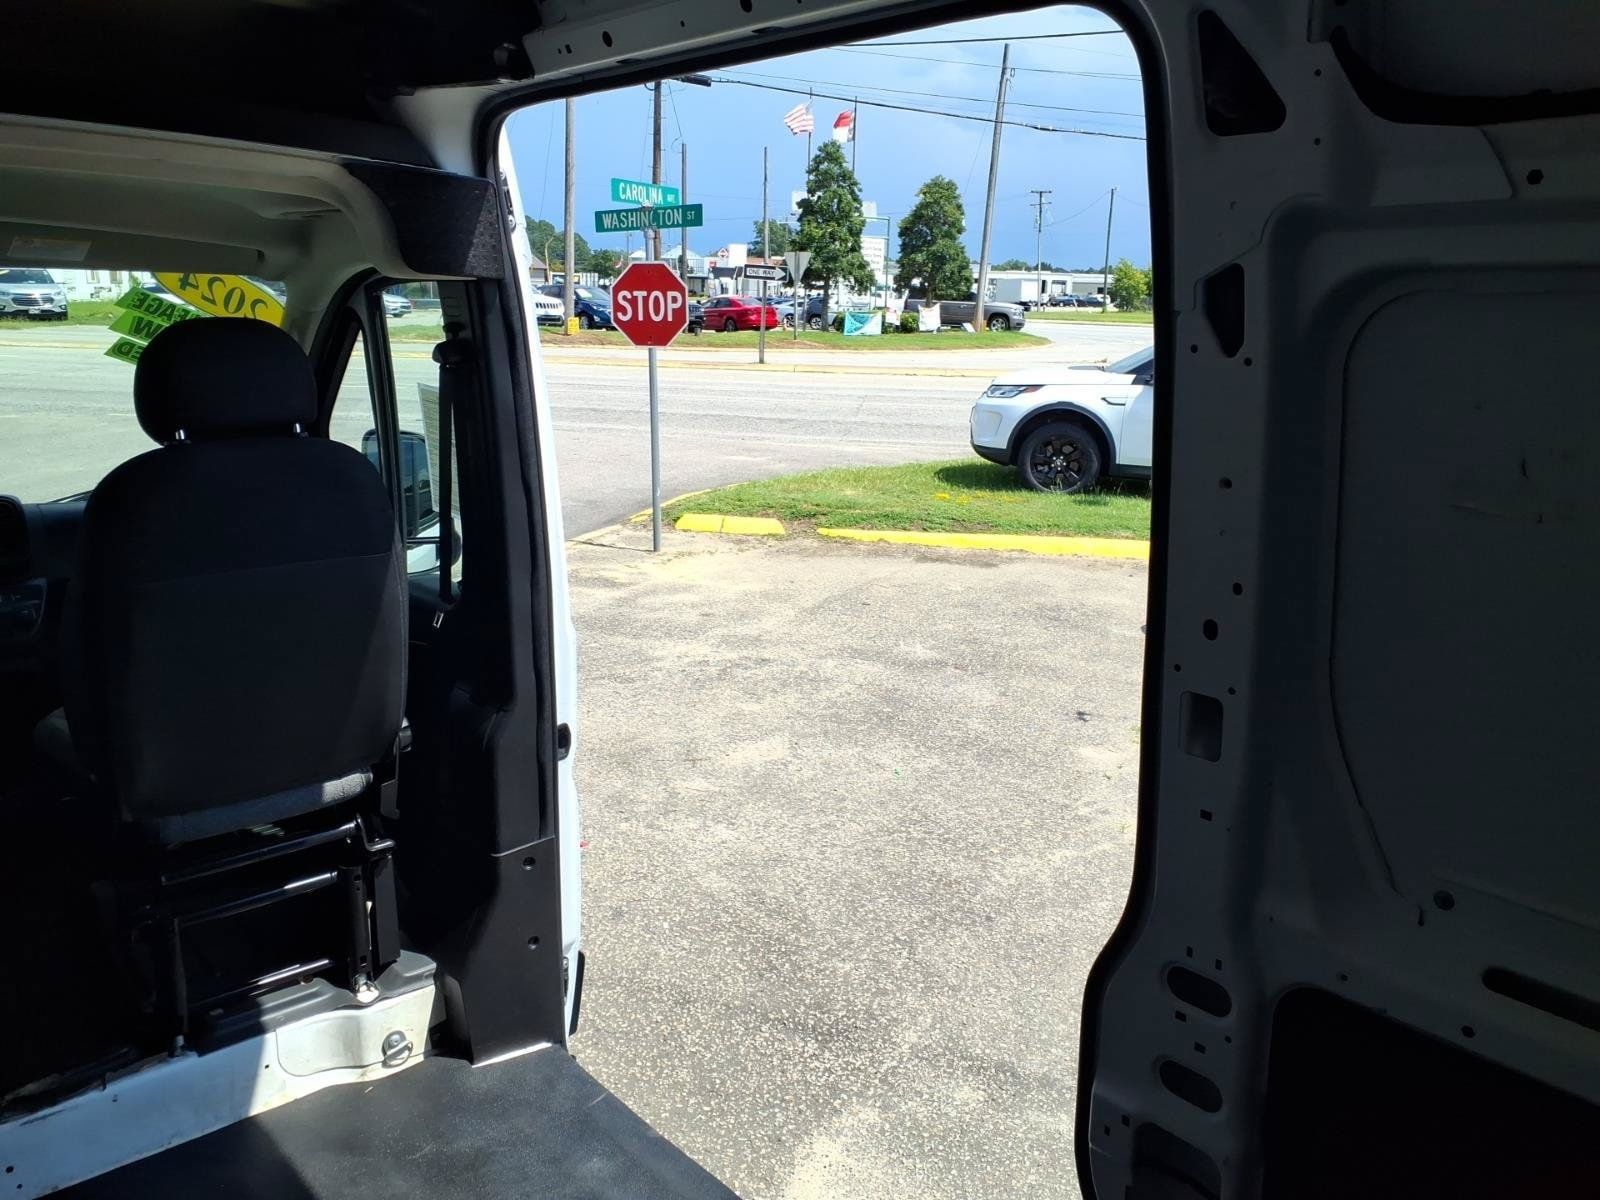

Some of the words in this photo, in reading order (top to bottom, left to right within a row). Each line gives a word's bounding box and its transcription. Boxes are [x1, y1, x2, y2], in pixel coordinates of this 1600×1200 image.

[619, 182, 663, 205] CAROLINA
[602, 208, 682, 229] WASHINGTON
[686, 211, 695, 220] ST
[748, 268, 760, 276] ONE
[617, 290, 683, 322] STOP
